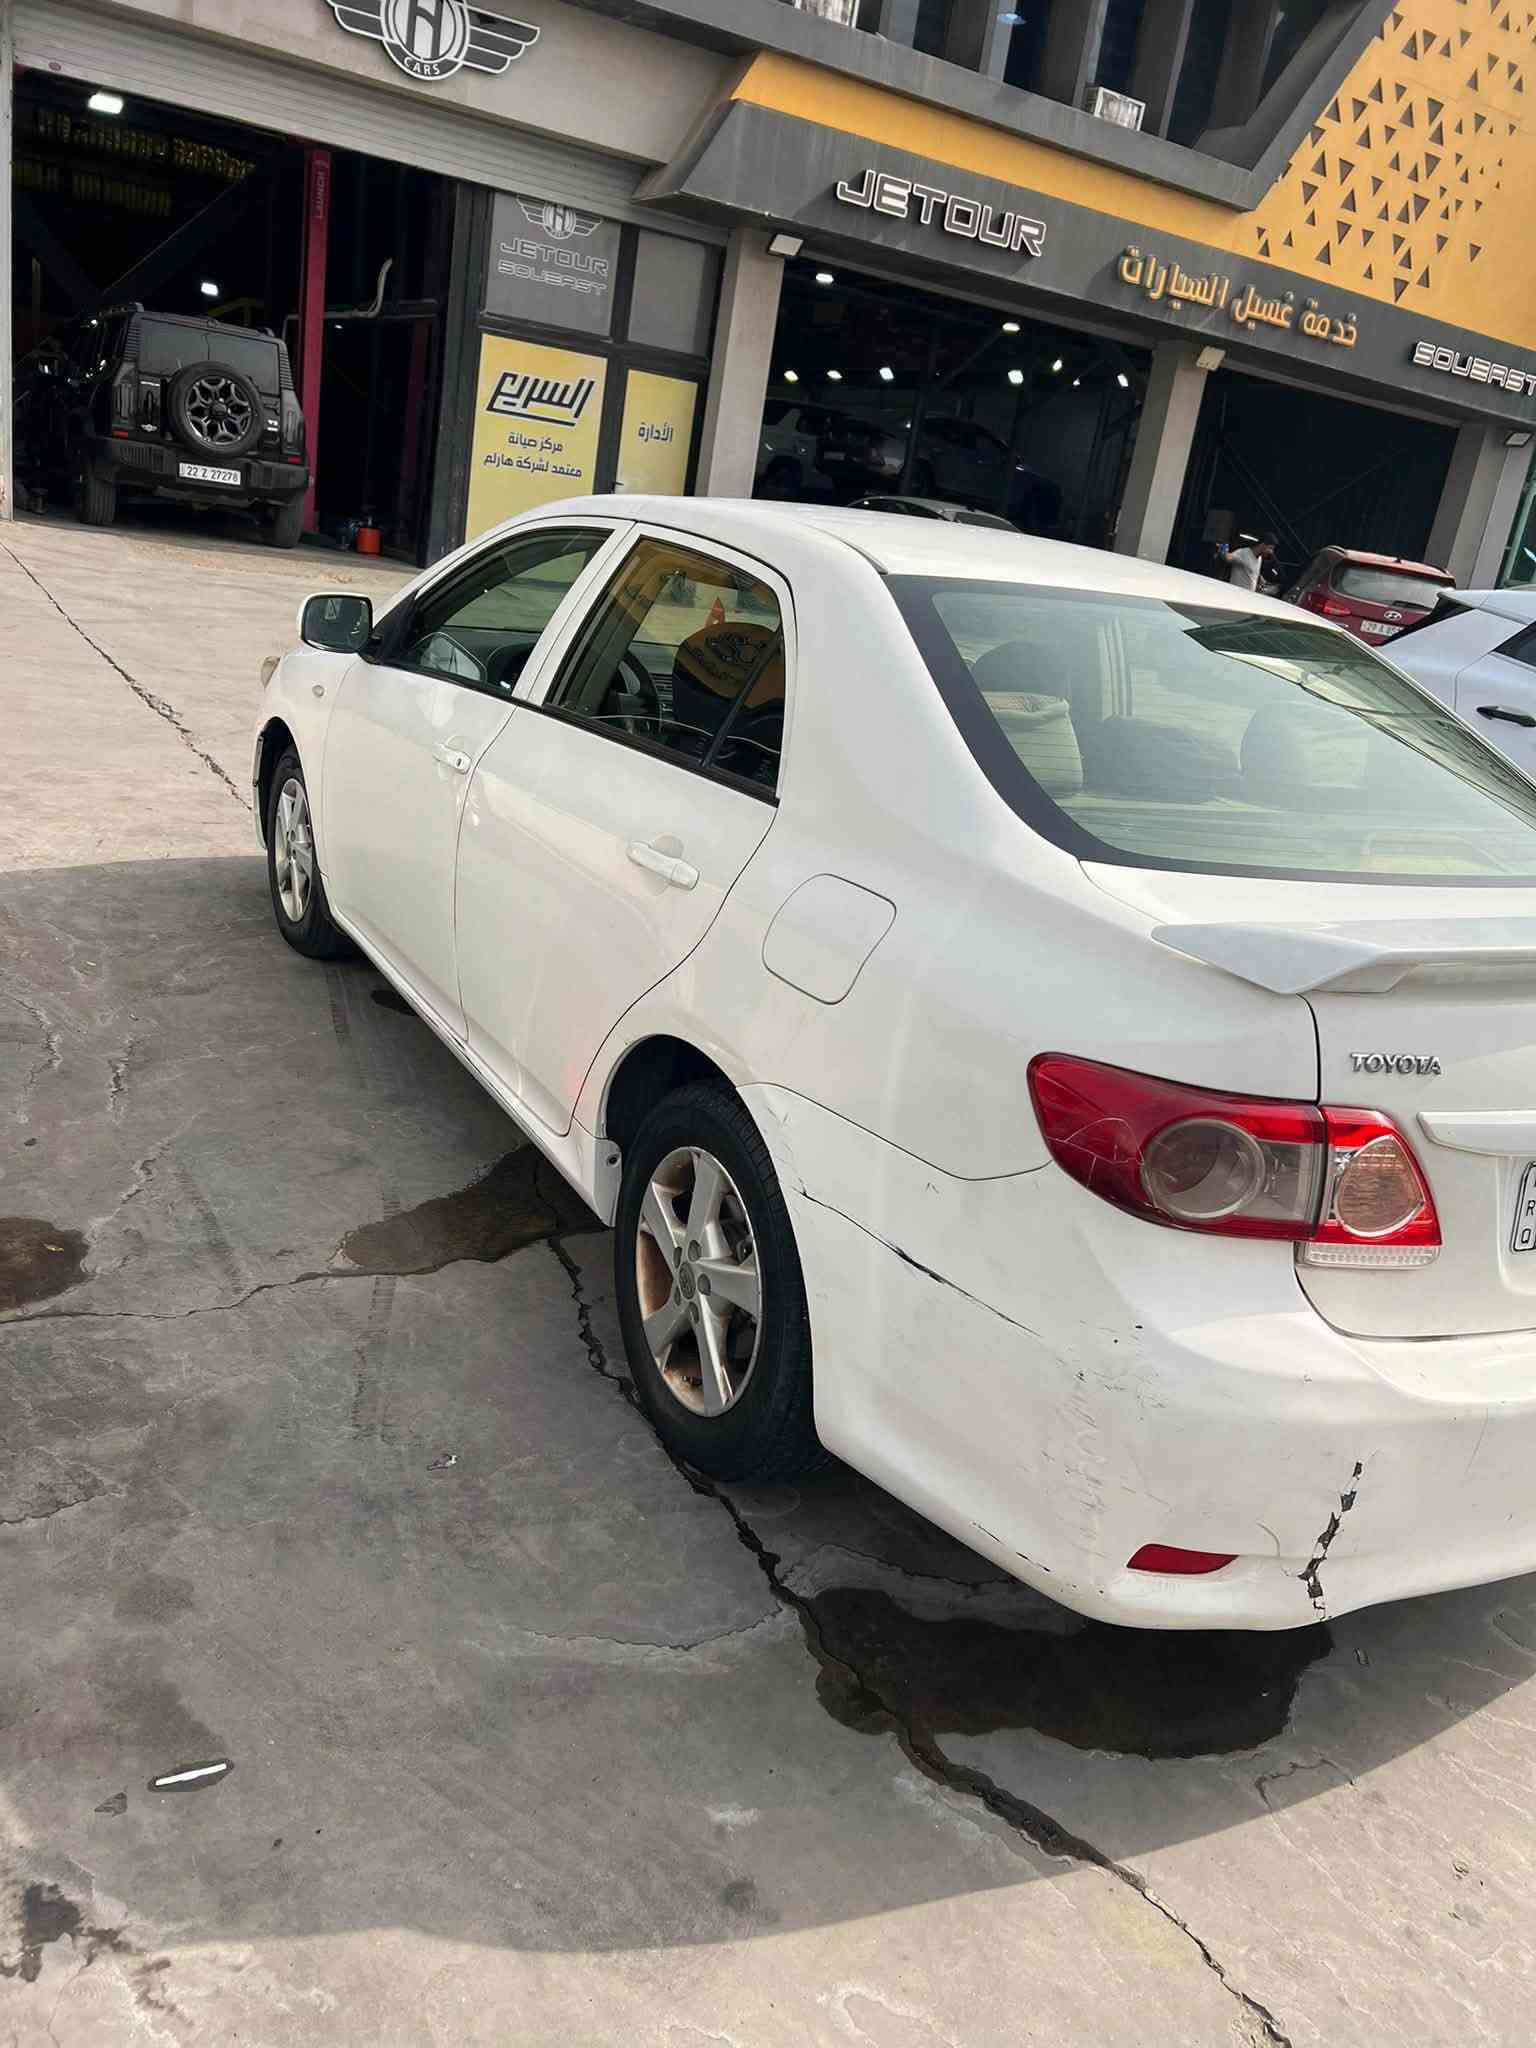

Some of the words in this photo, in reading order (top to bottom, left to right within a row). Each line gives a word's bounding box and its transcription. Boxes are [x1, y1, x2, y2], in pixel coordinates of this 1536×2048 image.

[403, 56, 440, 76] CARS
[836, 169, 1047, 257] JETOUR
[500, 238, 608, 277] JETOUR
[1119, 245, 1232, 311] السيارات
[1233, 285, 1295, 330] غسيل
[1302, 297, 1358, 348] خدمة
[1413, 341, 1536, 396] SOUEAST
[486, 371, 595, 427] السريع
[508, 431, 538, 449] صيانة
[540, 437, 564, 454] مركز
[187, 466, 199, 477] 22
[516, 456, 549, 473] لشركة
[551, 463, 582, 478] معتمد
[1351, 1053, 1442, 1076] TOYOTA
